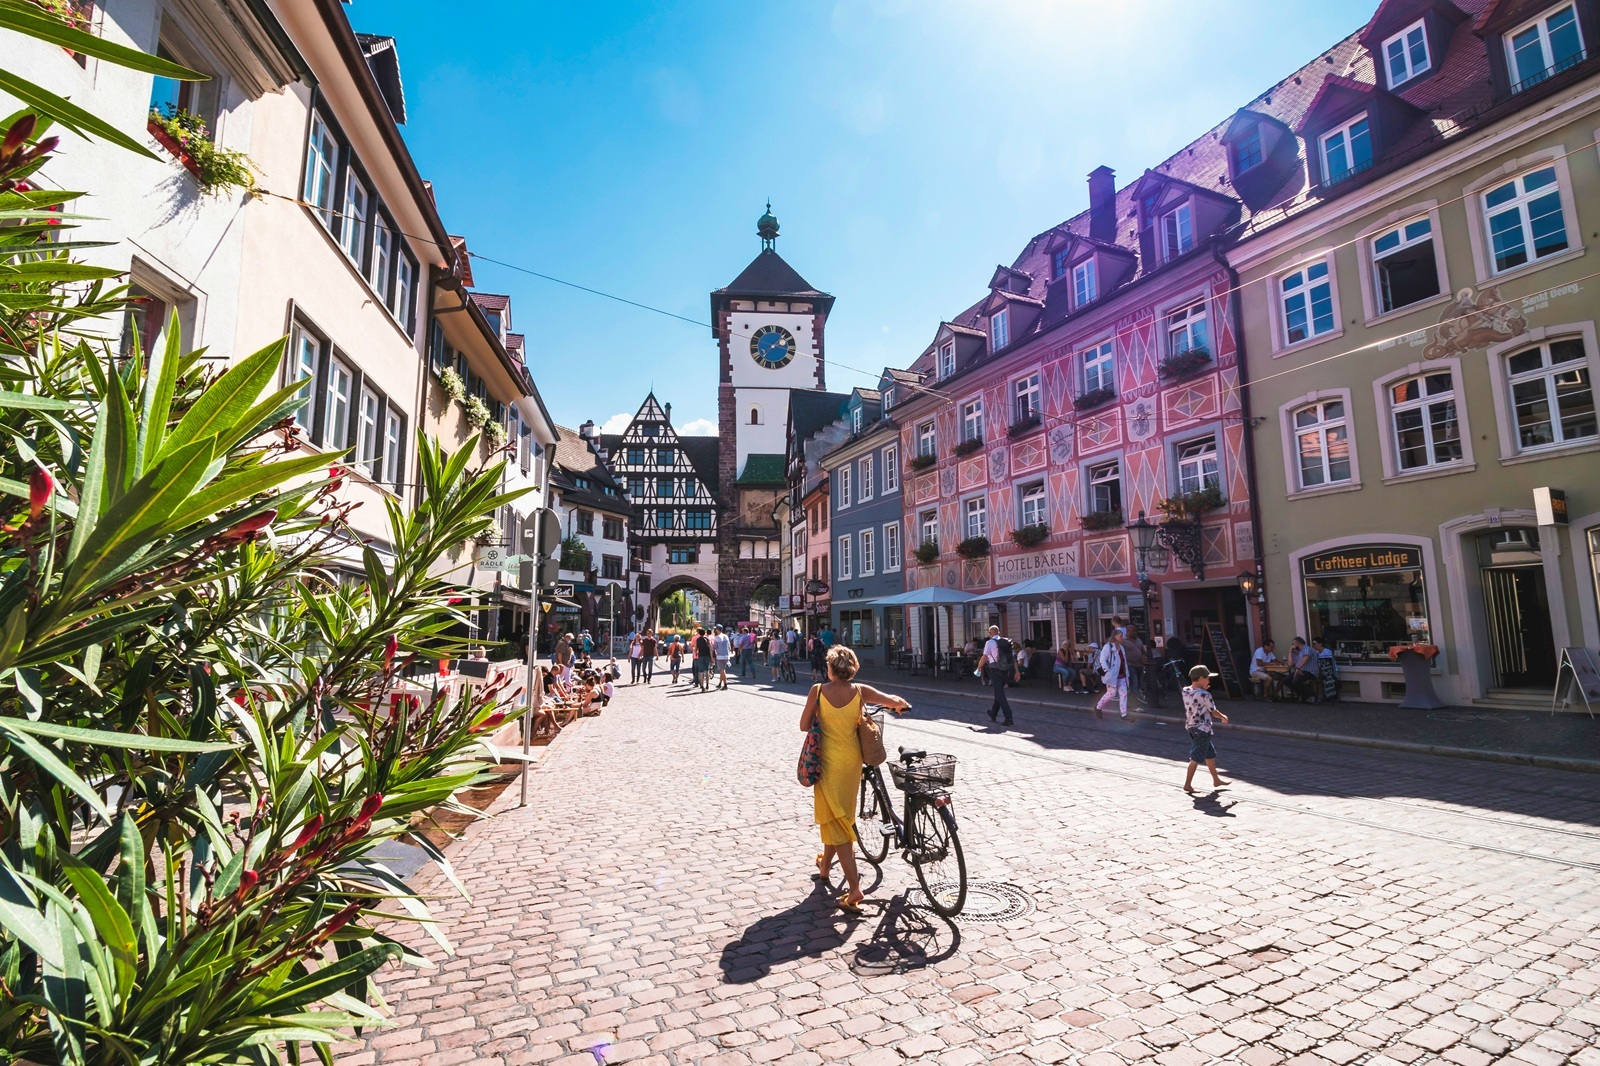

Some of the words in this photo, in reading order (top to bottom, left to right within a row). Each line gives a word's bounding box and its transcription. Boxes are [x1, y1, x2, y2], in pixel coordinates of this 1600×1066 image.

[1236, 527, 1249, 536] OBER
[997, 557, 1032, 573] HOTEL
[1034, 551, 1076, 569] BÄREN
[1314, 555, 1367, 571] Craftbeer
[1370, 551, 1408, 568] Lodge
